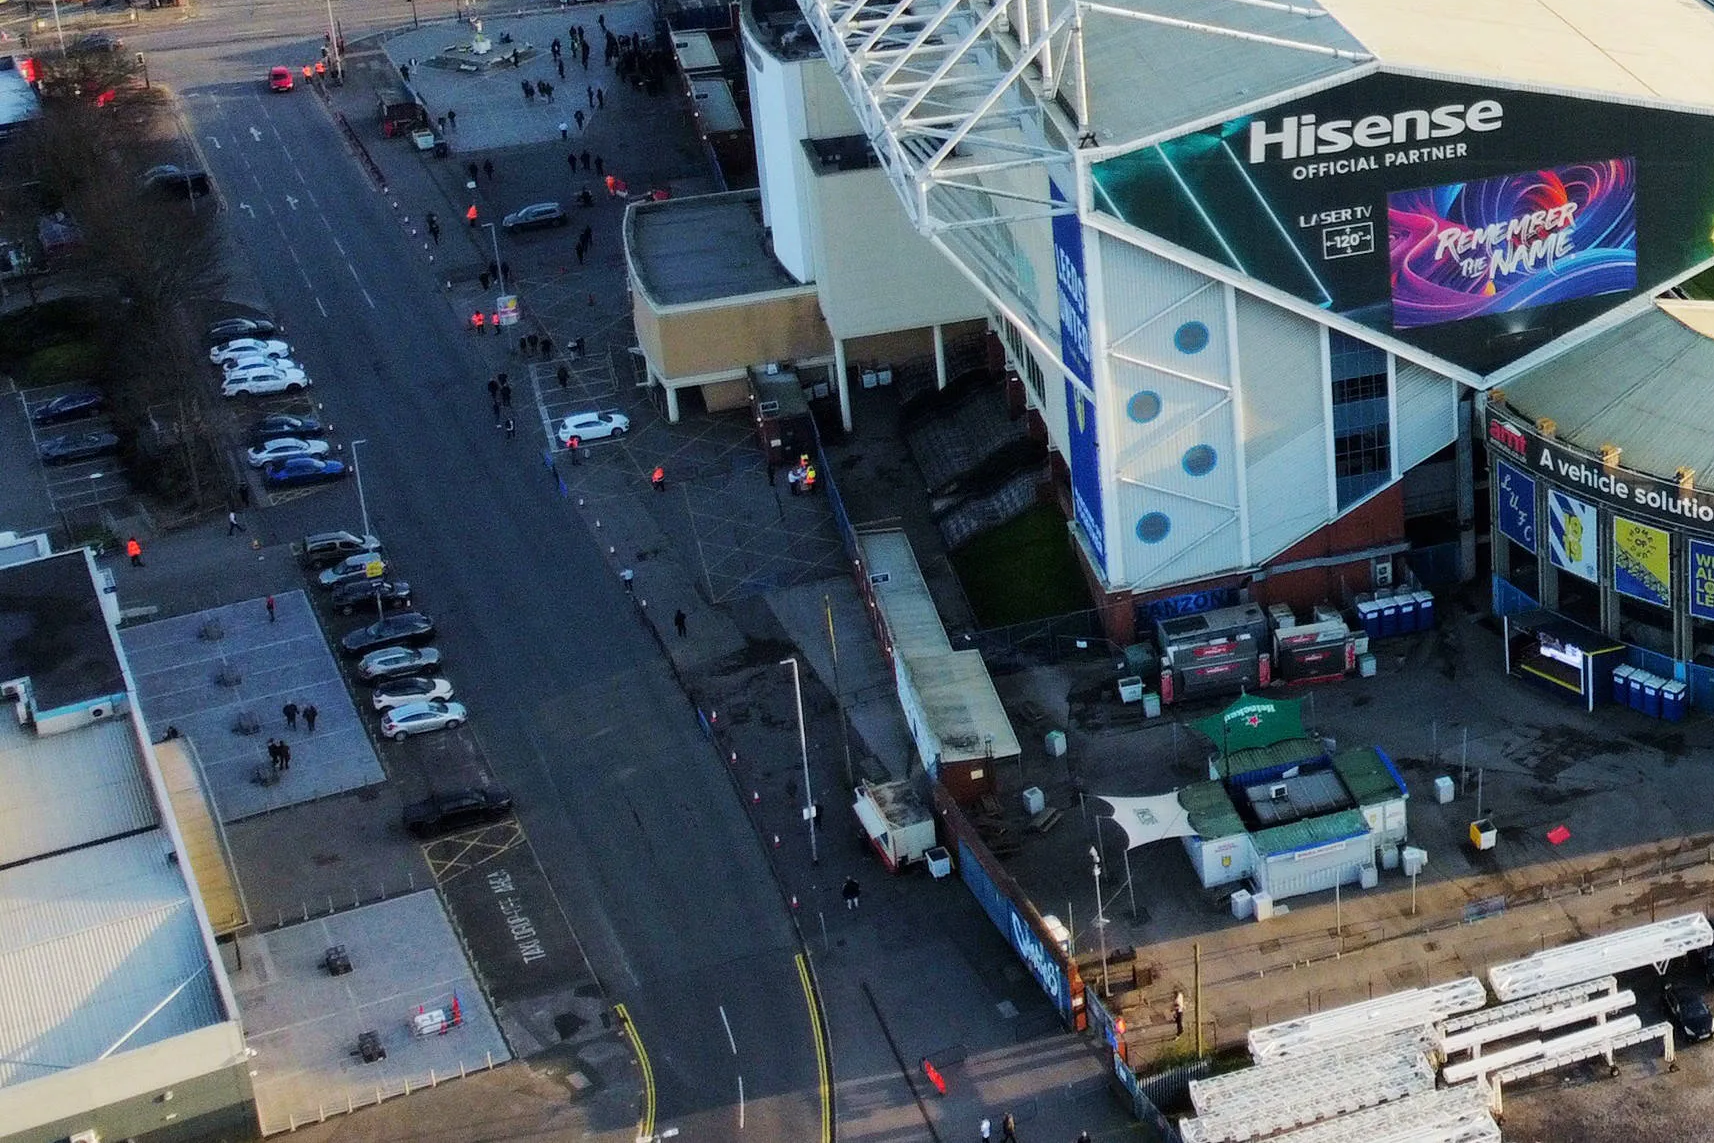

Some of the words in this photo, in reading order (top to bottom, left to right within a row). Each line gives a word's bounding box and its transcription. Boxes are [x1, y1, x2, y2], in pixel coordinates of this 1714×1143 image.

[1250, 99, 1503, 164] Hisense
[1292, 155, 1379, 180] OFFICIAL
[1385, 142, 1467, 167] PARTNER
[1353, 205, 1372, 219] TV
[1435, 202, 1578, 262] REMEMBER
[1055, 241, 1085, 315] LEEDS
[1461, 256, 1488, 278] THE
[1489, 228, 1576, 279] NAME
[1489, 418, 1527, 456] amt
[1539, 448, 1554, 471] A
[1557, 459, 1629, 499] vehicle
[1223, 704, 1276, 724] Heineken
